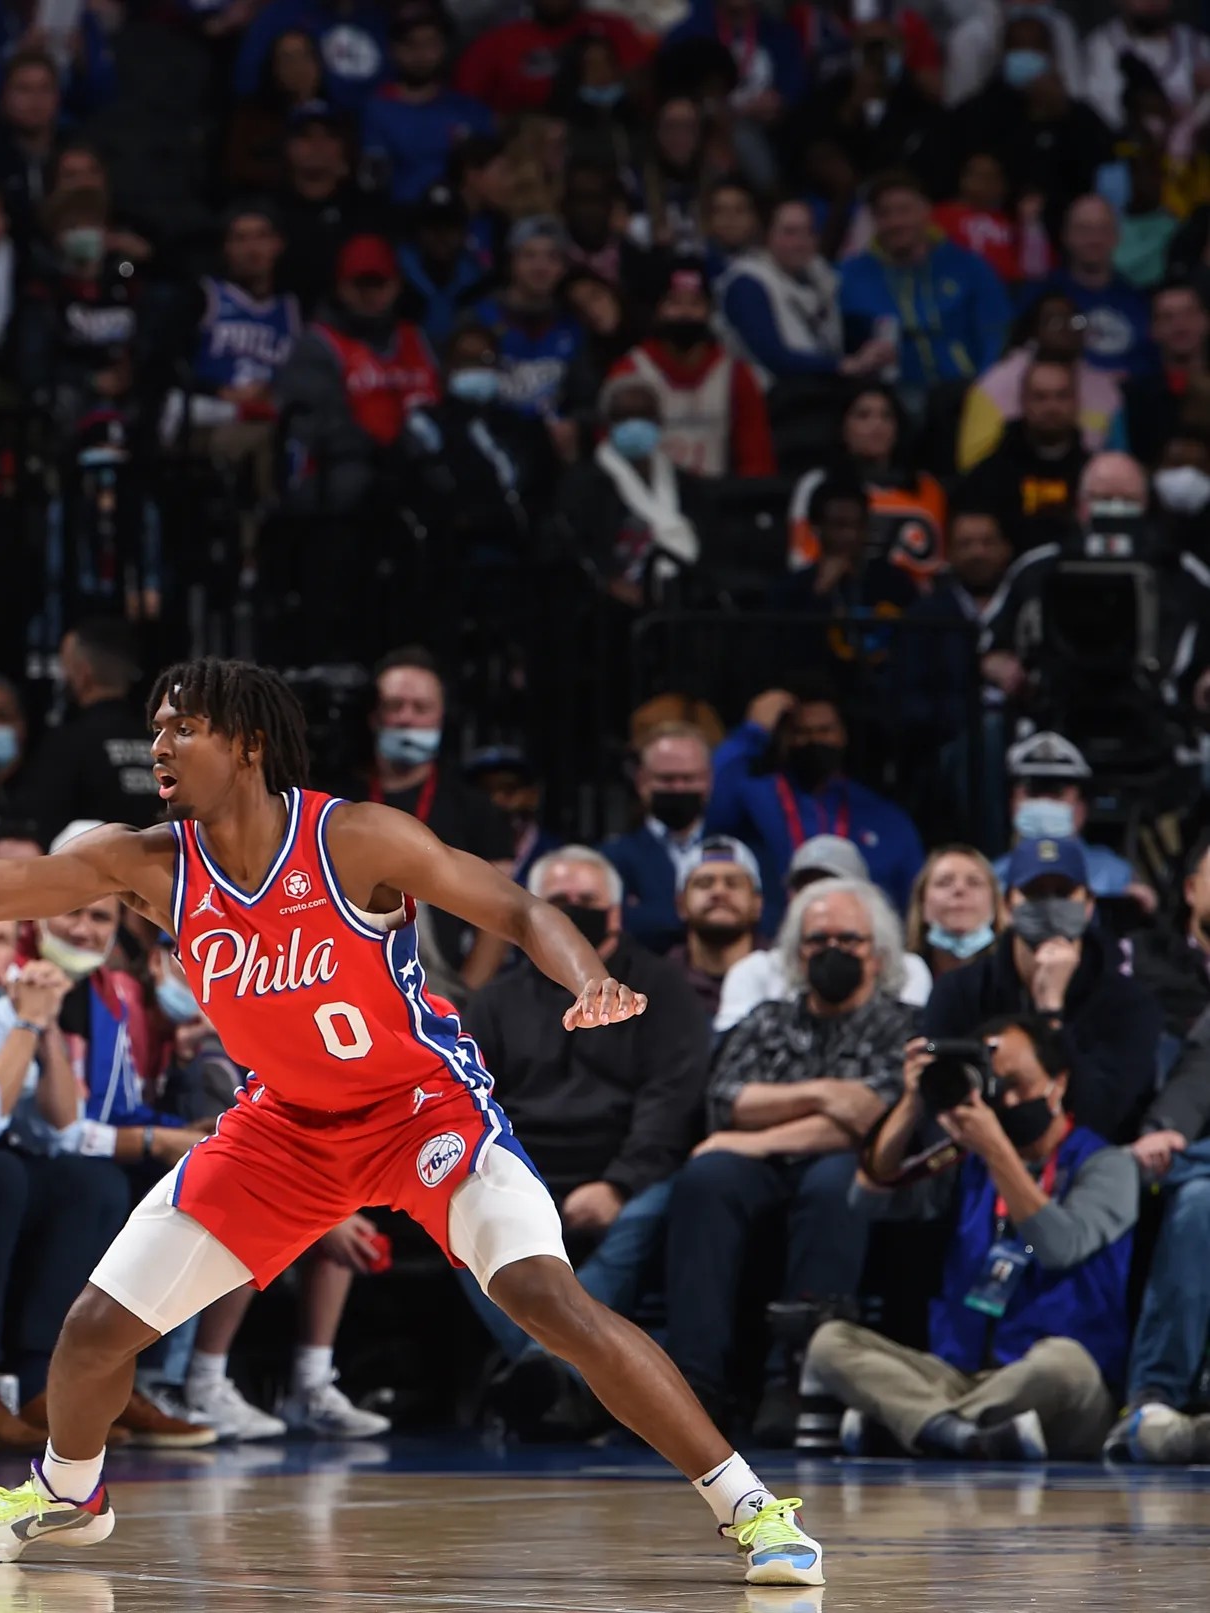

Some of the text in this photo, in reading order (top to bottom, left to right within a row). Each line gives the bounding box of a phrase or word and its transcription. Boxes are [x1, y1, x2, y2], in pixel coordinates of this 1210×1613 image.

[278, 897, 327, 916] crypto.com
[190, 927, 339, 1004] Phila
[313, 1001, 373, 1060] 0
